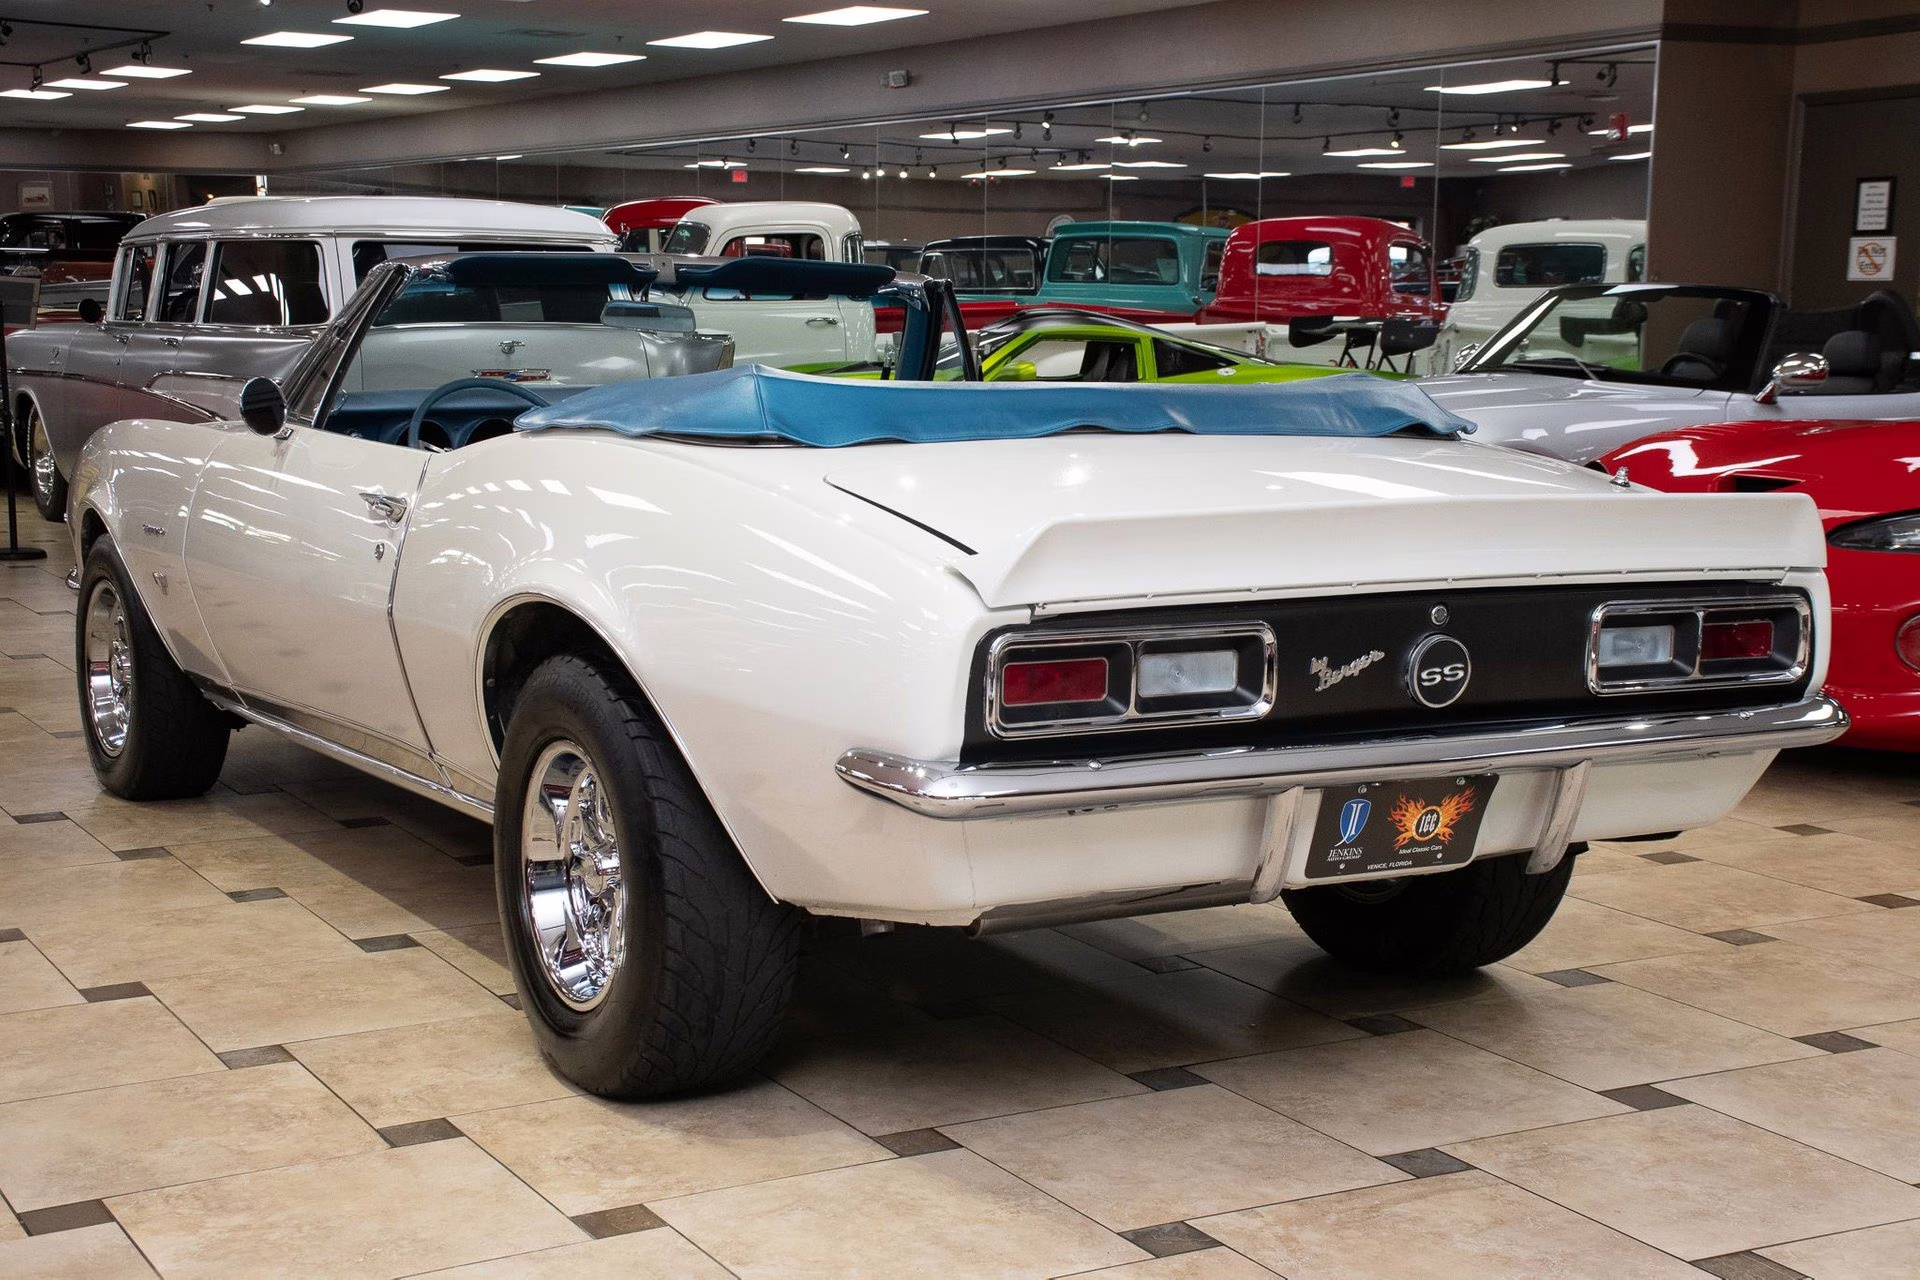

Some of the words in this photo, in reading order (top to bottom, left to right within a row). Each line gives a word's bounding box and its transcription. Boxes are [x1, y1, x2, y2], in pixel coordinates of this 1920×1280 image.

[1420, 663, 1465, 686] SS
[1418, 813, 1437, 833] ICC
[1328, 847, 1363, 857] JENKINS
[1412, 846, 1430, 854] Classic
[1388, 860, 1413, 868] FLORIDA
